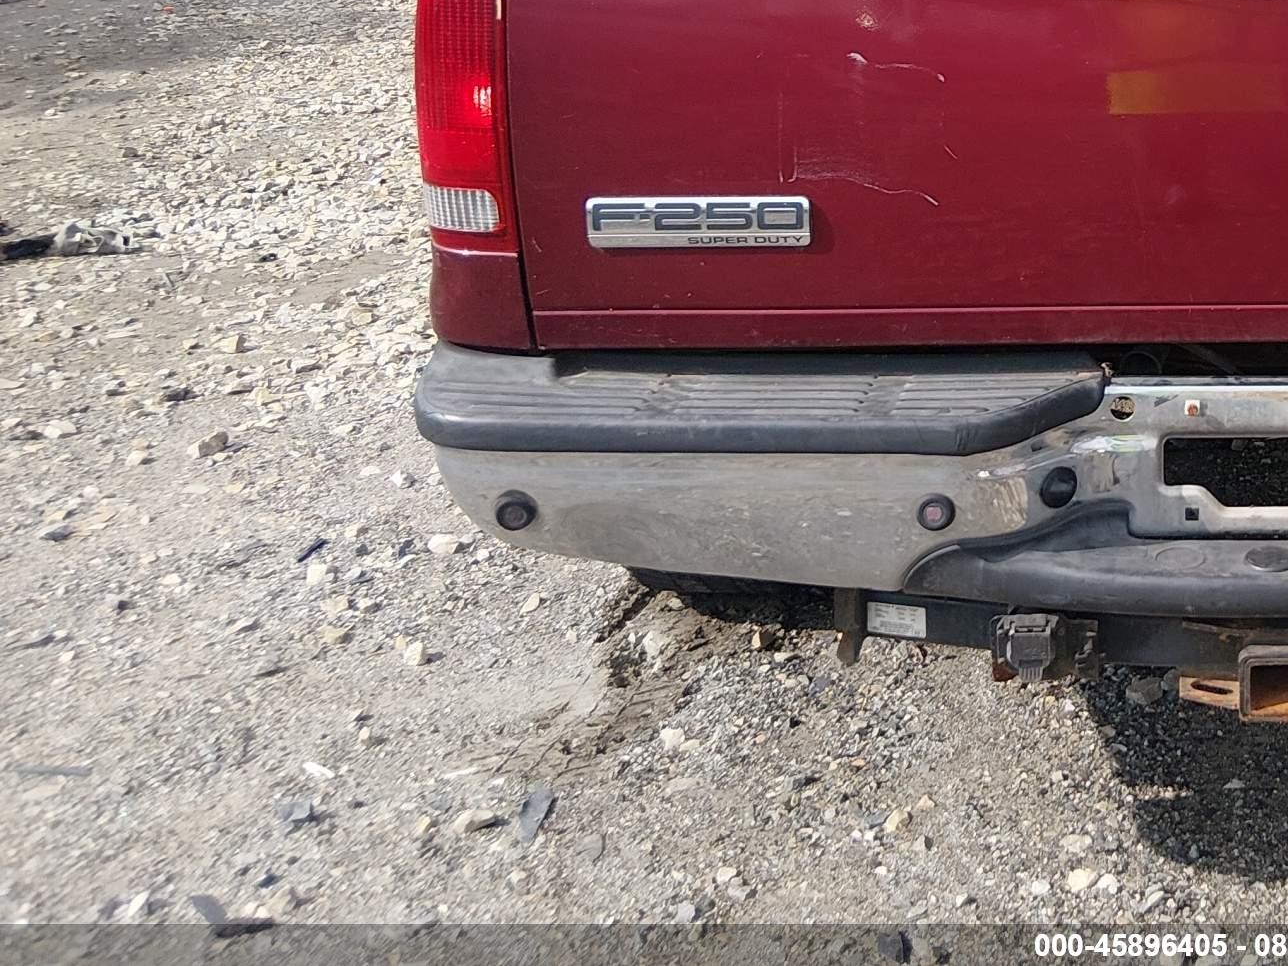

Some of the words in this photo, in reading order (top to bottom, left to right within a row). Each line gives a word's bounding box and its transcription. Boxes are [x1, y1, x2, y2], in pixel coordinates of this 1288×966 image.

[592, 202, 804, 231] F-250
[687, 236, 748, 244] SUPER
[754, 236, 804, 244] DUTY
